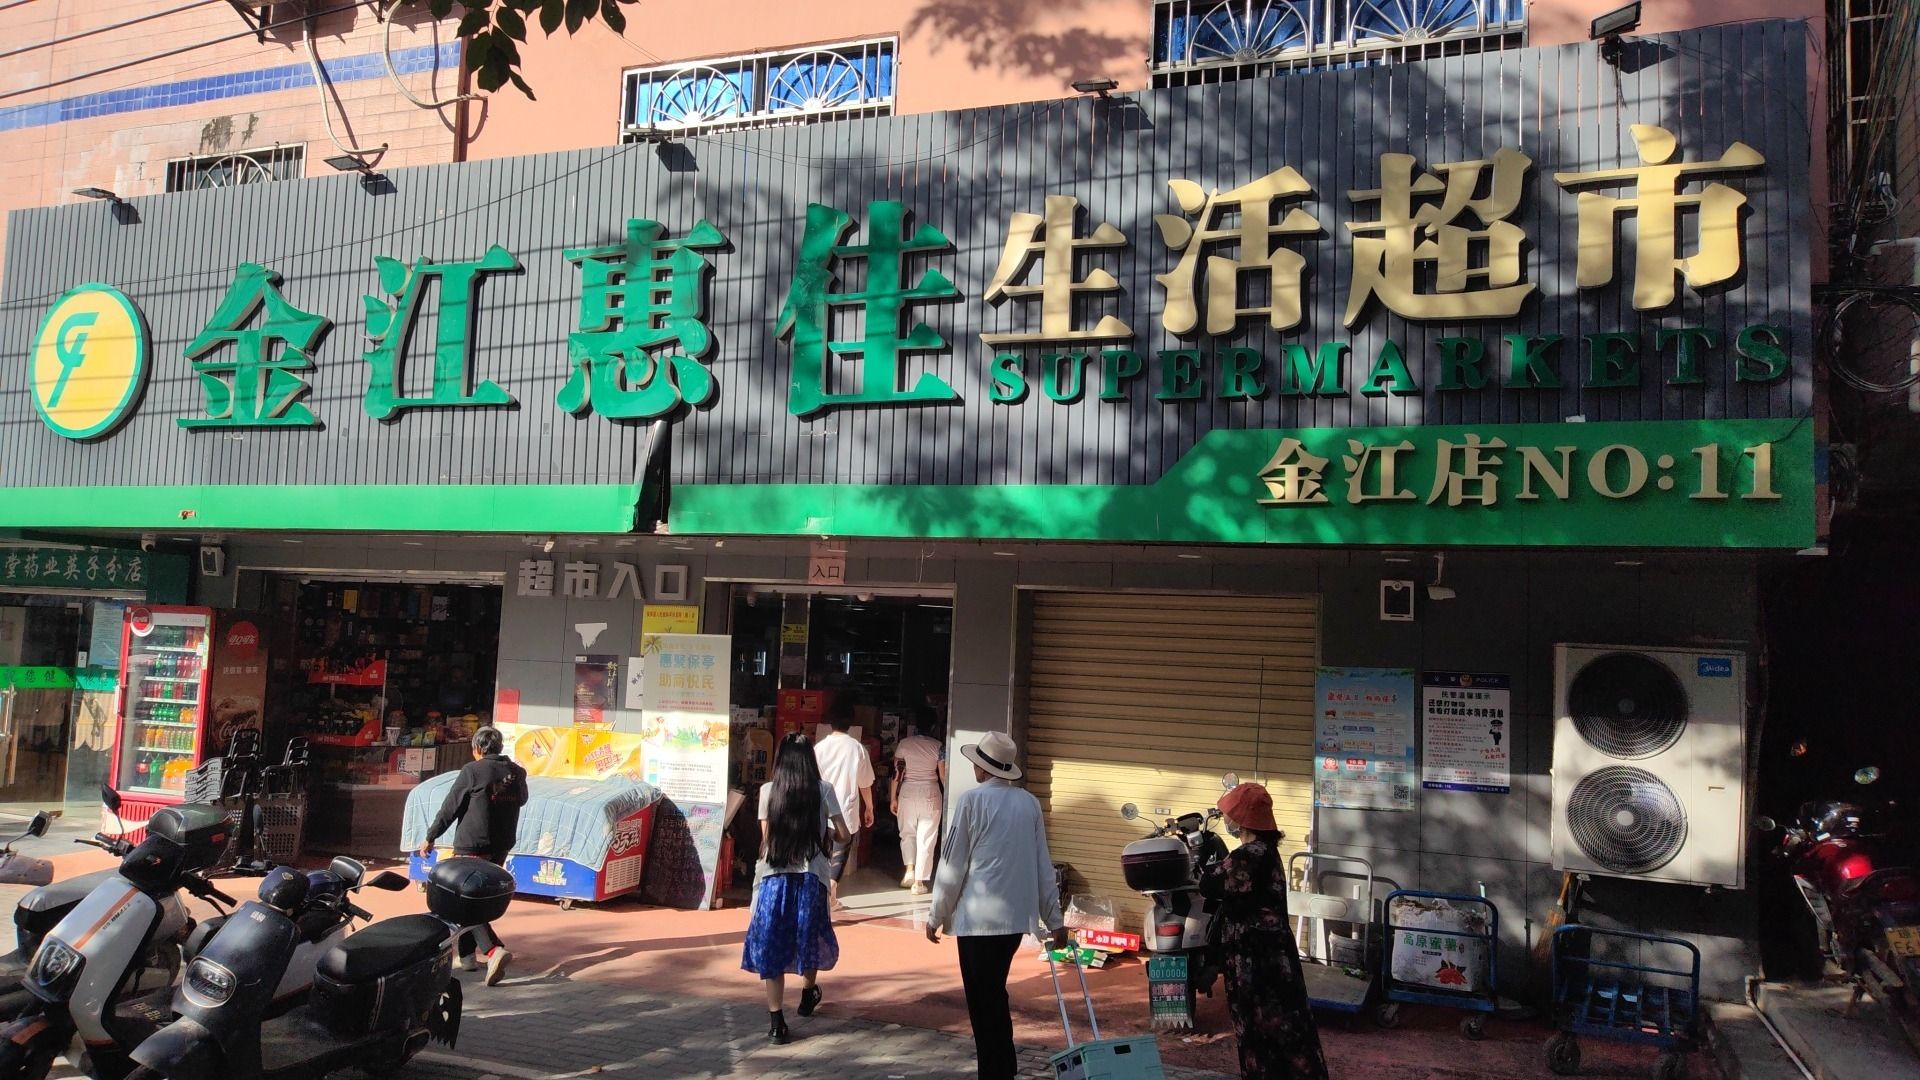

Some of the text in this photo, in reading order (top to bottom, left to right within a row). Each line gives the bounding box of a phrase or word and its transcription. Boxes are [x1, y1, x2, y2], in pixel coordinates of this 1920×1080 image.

[988, 323, 1791, 403] SUPERMARKETS
[517, 559, 687, 600] 超市入口
[812, 565, 840, 579] 入口
